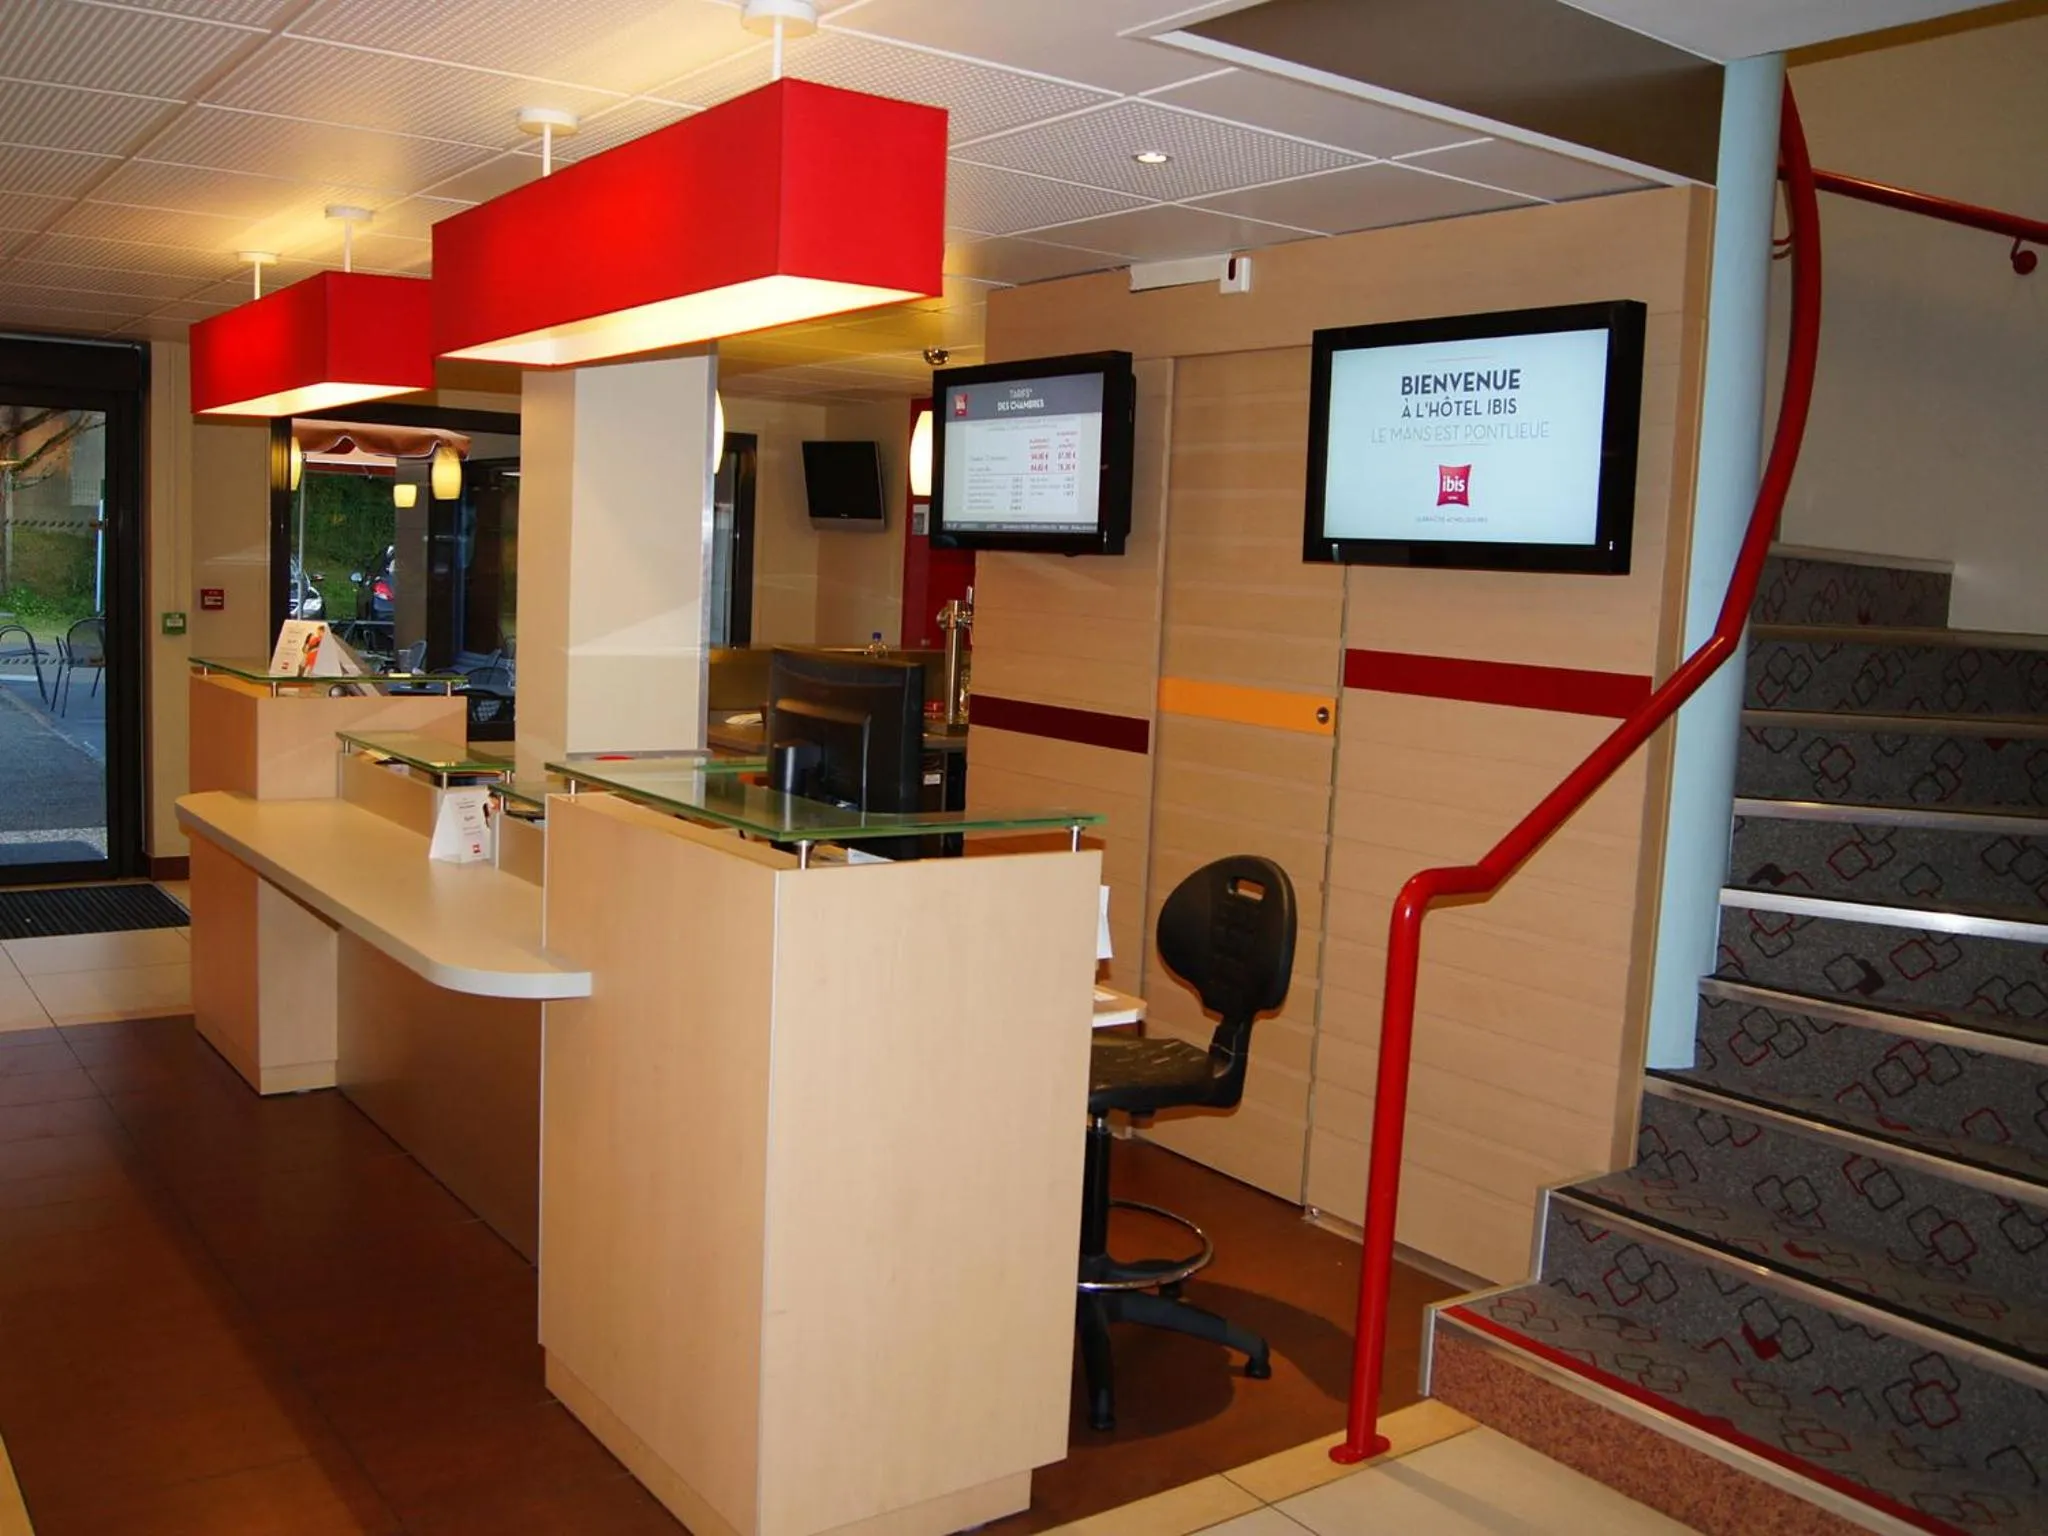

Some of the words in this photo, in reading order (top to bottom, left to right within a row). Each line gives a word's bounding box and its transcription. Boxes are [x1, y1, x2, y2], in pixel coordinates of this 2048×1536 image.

[1401, 369, 1521, 395] BIENVENUE
[1401, 398, 1412, 418] À
[1416, 396, 1482, 418] L'HÔTEL
[1487, 398, 1517, 415] IBIS
[1371, 427, 1387, 443] LE
[1390, 425, 1433, 442] MANS
[1435, 425, 1460, 440] EST
[1464, 421, 1550, 440] PONTLIEUE
[1442, 475, 1465, 493] ibis
